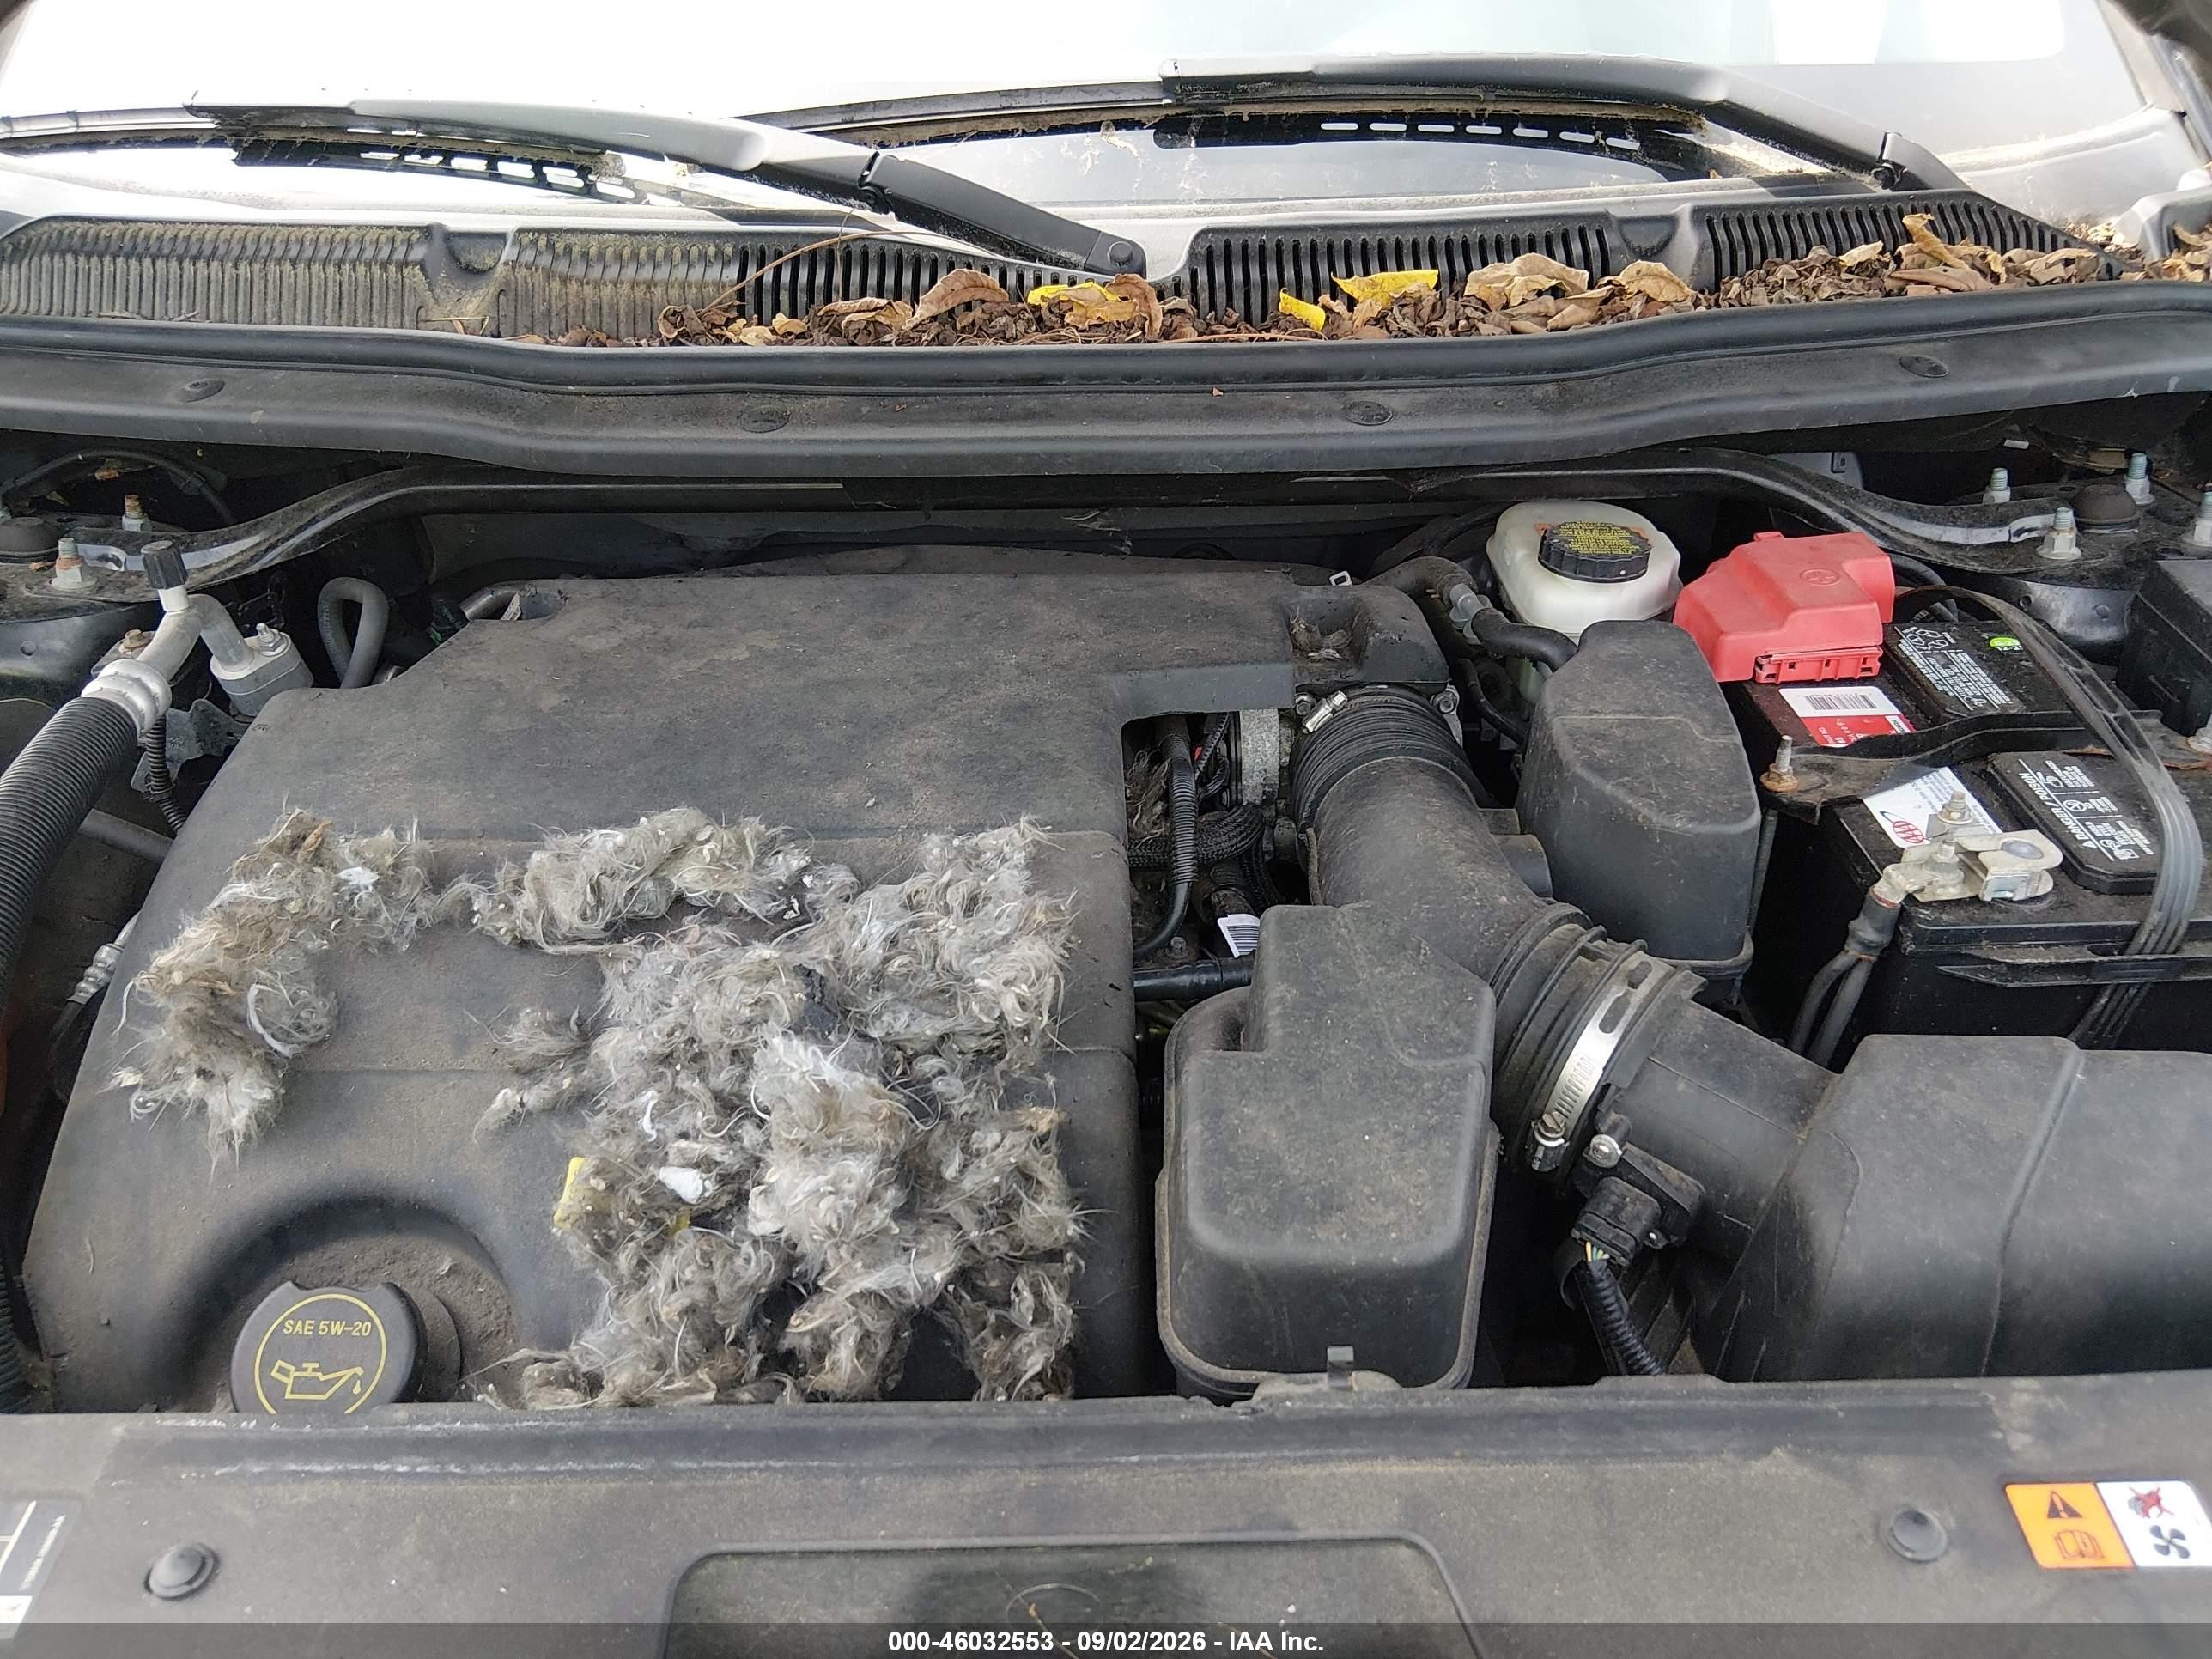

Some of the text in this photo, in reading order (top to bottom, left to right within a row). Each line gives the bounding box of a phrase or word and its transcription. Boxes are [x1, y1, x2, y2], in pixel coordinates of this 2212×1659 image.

[2018, 772, 2053, 800] POISON
[1893, 821, 1923, 843] AAA
[2050, 807, 2089, 840] DANGER
[283, 1319, 372, 1336] SAE 5W-20
